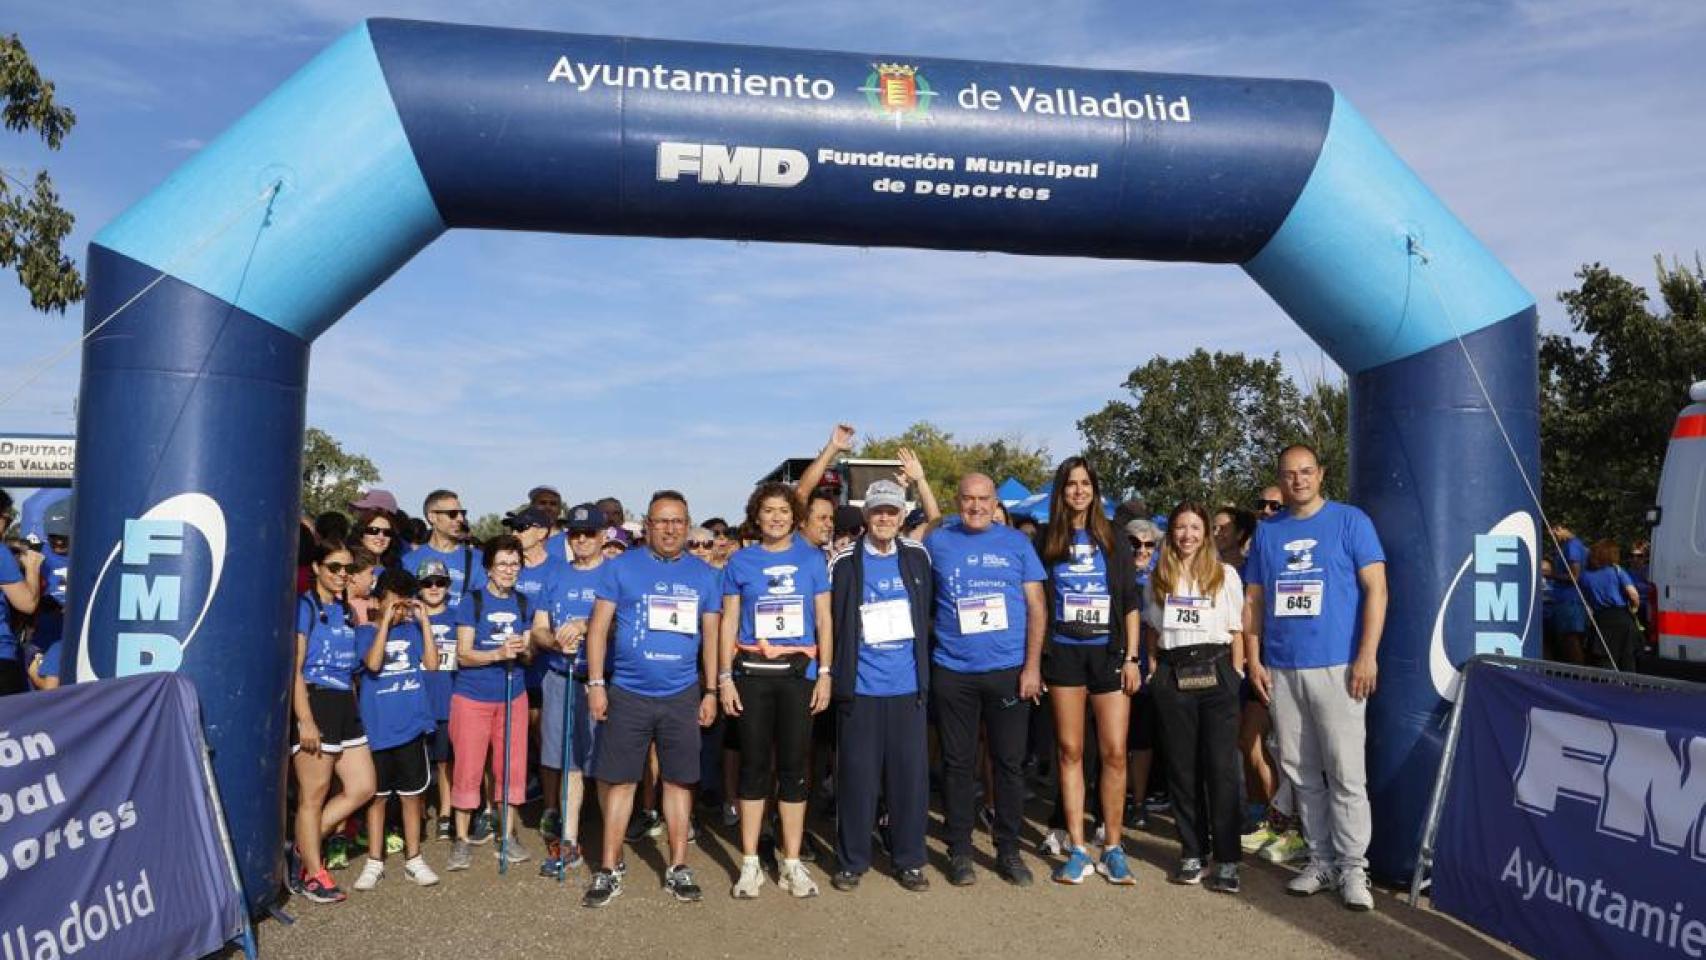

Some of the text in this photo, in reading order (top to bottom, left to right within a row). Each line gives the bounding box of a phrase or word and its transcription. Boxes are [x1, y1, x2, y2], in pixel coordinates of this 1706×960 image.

[547, 55, 1191, 122] Ayuntamiento de Valladolid
[656, 141, 810, 188] FMD
[817, 148, 1099, 179] Fundación Municipal
[872, 177, 1051, 201] de Deportes
[1, 442, 74, 455] DIPUTACI
[0, 460, 15, 470] DE
[116, 519, 184, 679] FMD
[1287, 596, 1312, 609] 645
[668, 611, 679, 626] 4
[980, 610, 989, 625] 2
[1076, 608, 1100, 623] 644
[1175, 608, 1200, 624] 735
[775, 616, 785, 631] 3
[0, 800, 138, 880] ortes
